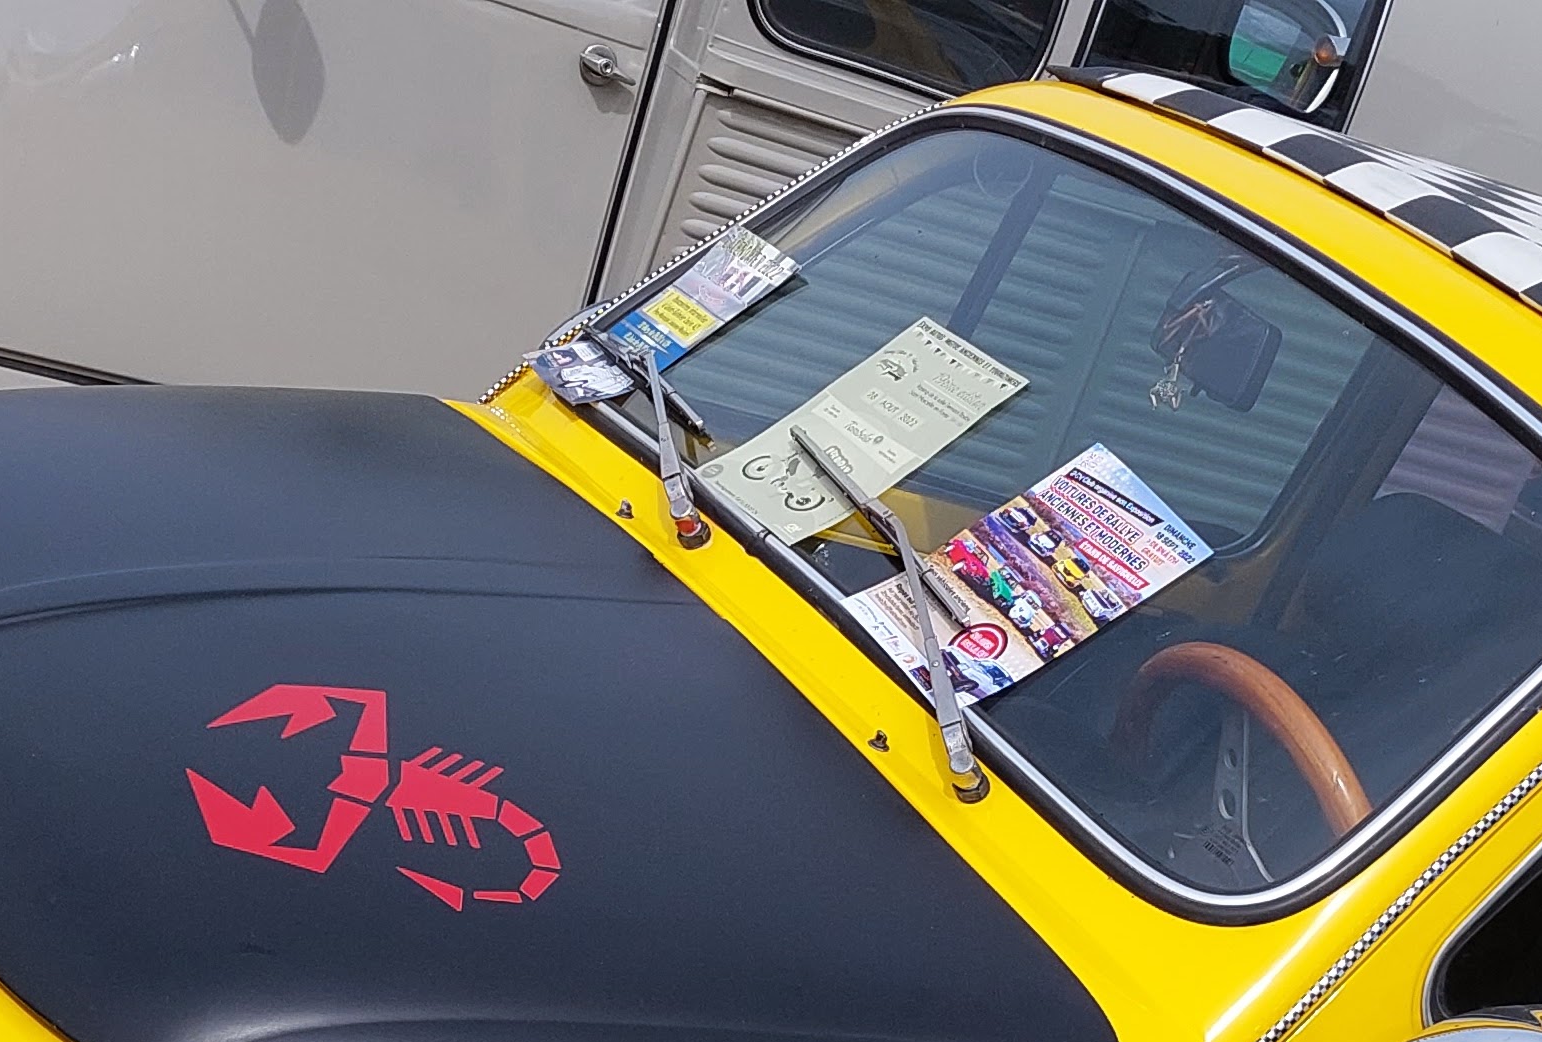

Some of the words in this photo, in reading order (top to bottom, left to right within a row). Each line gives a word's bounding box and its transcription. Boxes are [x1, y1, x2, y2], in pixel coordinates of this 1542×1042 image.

[1039, 489, 1089, 528] ANCIENNES
[1084, 522, 1099, 535] ET
[1095, 529, 1147, 572] MODERNES
[1053, 475, 1097, 511] VOITURES
[1092, 505, 1107, 519] DE
[1102, 513, 1141, 544] RALLYE
